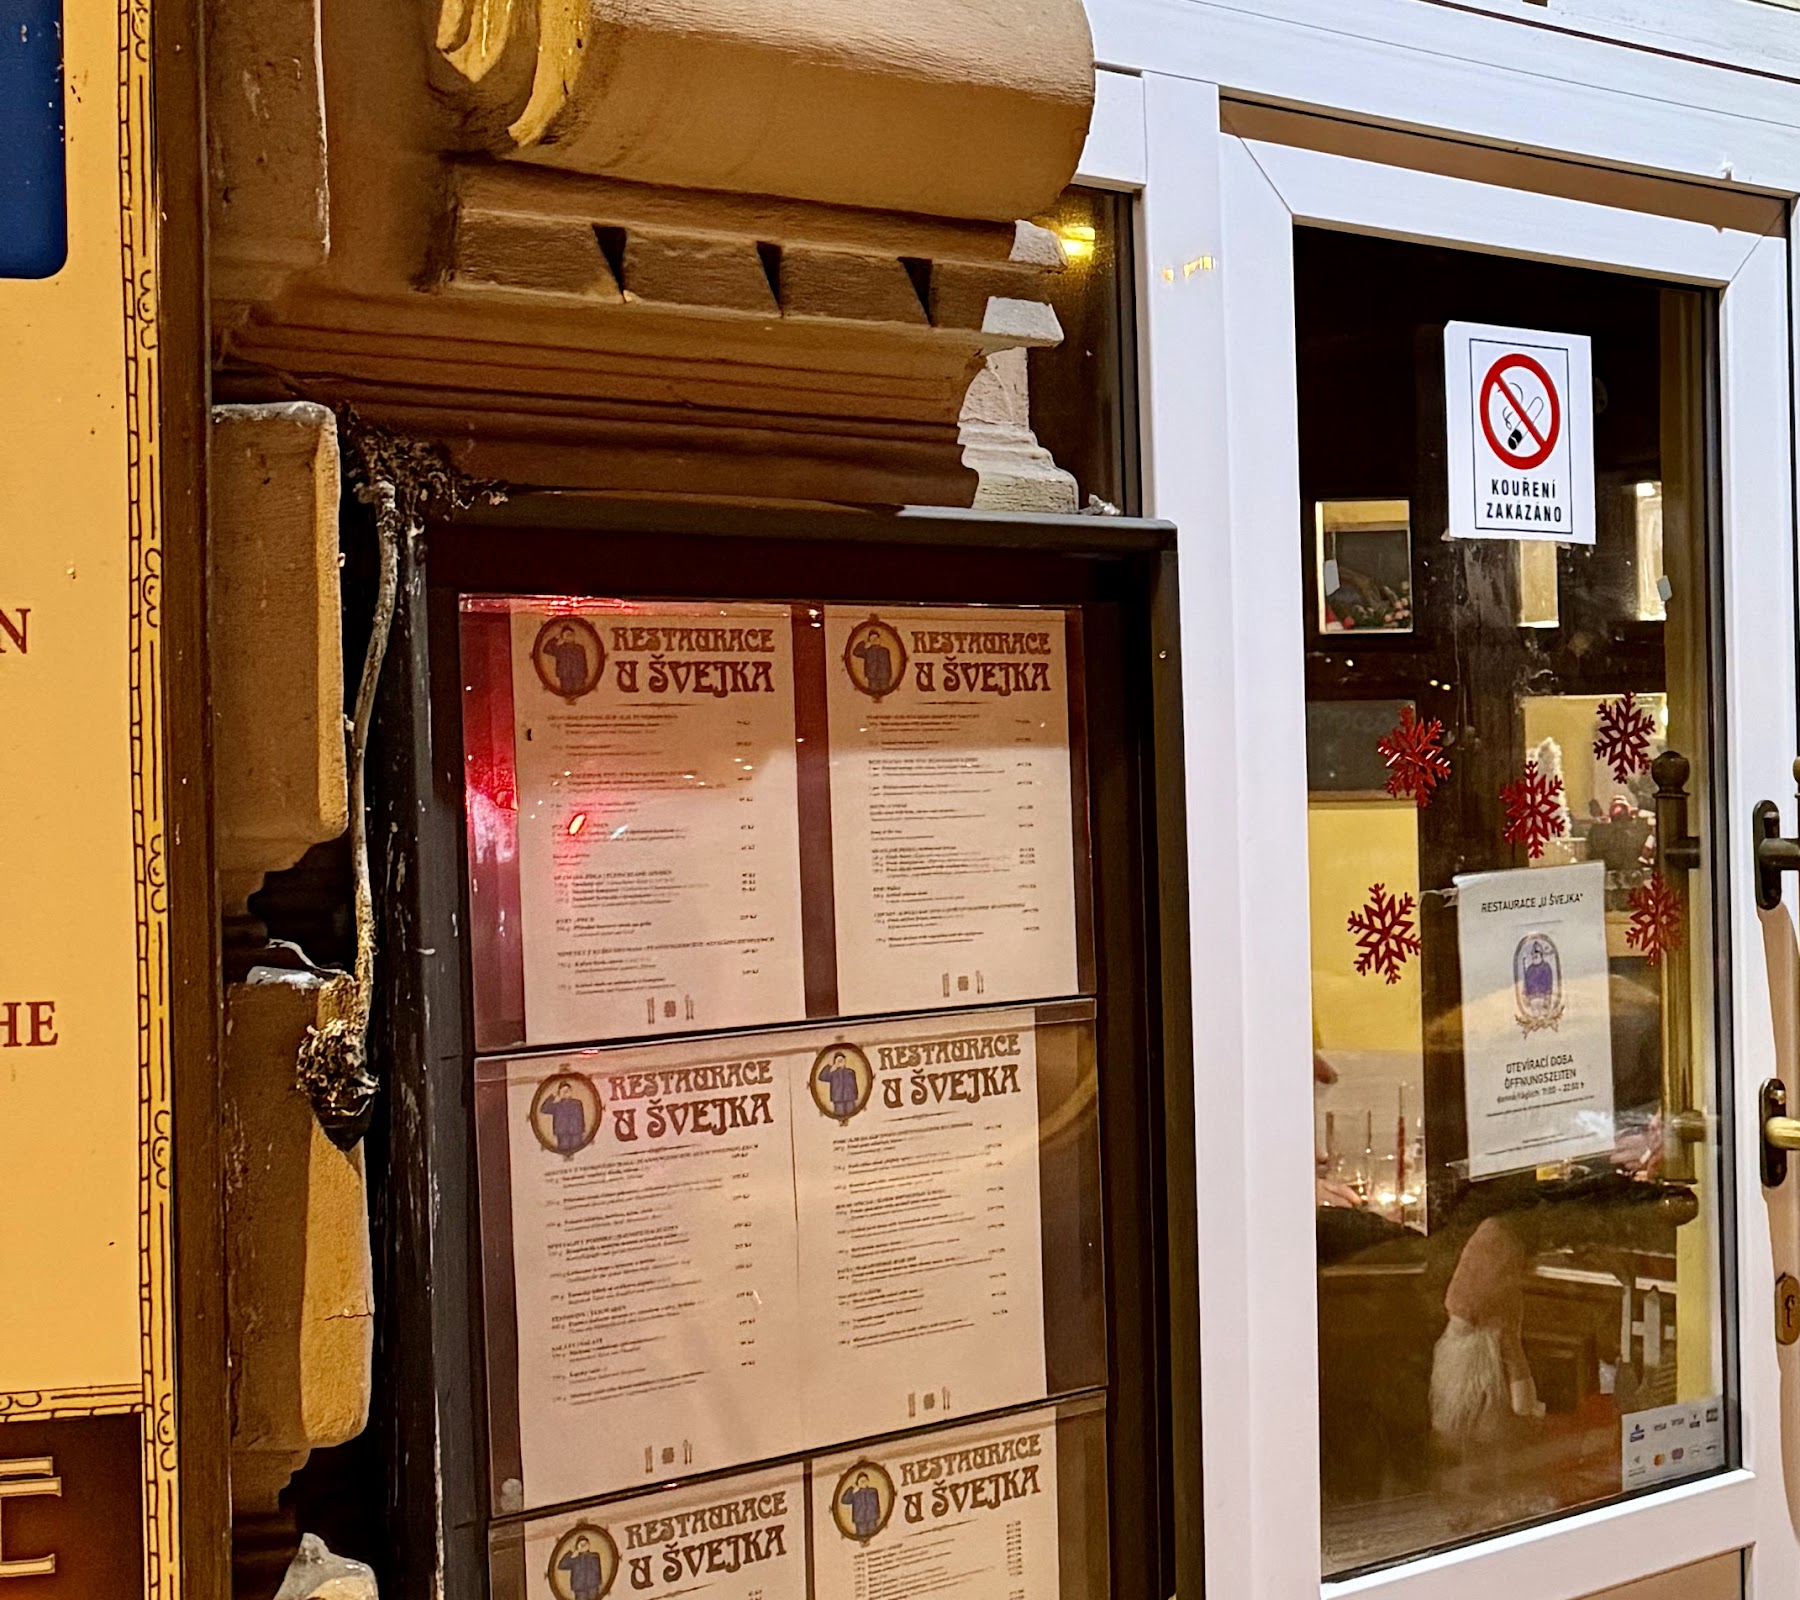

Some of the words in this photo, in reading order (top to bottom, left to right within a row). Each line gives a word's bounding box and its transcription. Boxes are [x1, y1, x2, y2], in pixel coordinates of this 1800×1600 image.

[1491, 477, 1556, 499] KOUŘENÍ
[1486, 500, 1562, 523] ZAKÁZÁNO
[610, 626, 776, 653] RESTAURACE
[910, 631, 1052, 656] RESTAURACE
[614, 660, 640, 693] U
[648, 654, 775, 699] ŠVEJKA
[914, 662, 937, 692] U
[942, 655, 1052, 697] ŠVEJKA
[1480, 897, 1536, 913] RESTAURACE
[877, 1033, 1022, 1071] RESTAURACE
[1506, 1055, 1549, 1074] OTEVÍRACÍ
[607, 1059, 774, 1101] RESTAURACE
[881, 1078, 904, 1109] U
[910, 1064, 1022, 1104] ŠVEJKA
[612, 1108, 638, 1142] U
[646, 1092, 774, 1138] ŠVEJKA
[899, 1433, 1042, 1487] RESTAURACE
[903, 1491, 924, 1524] U
[931, 1464, 1041, 1518] ŠVEJKA
[624, 1490, 788, 1550] RESTAURACE
[628, 1555, 654, 1590] U
[662, 1524, 787, 1583] ŠVEJKA
